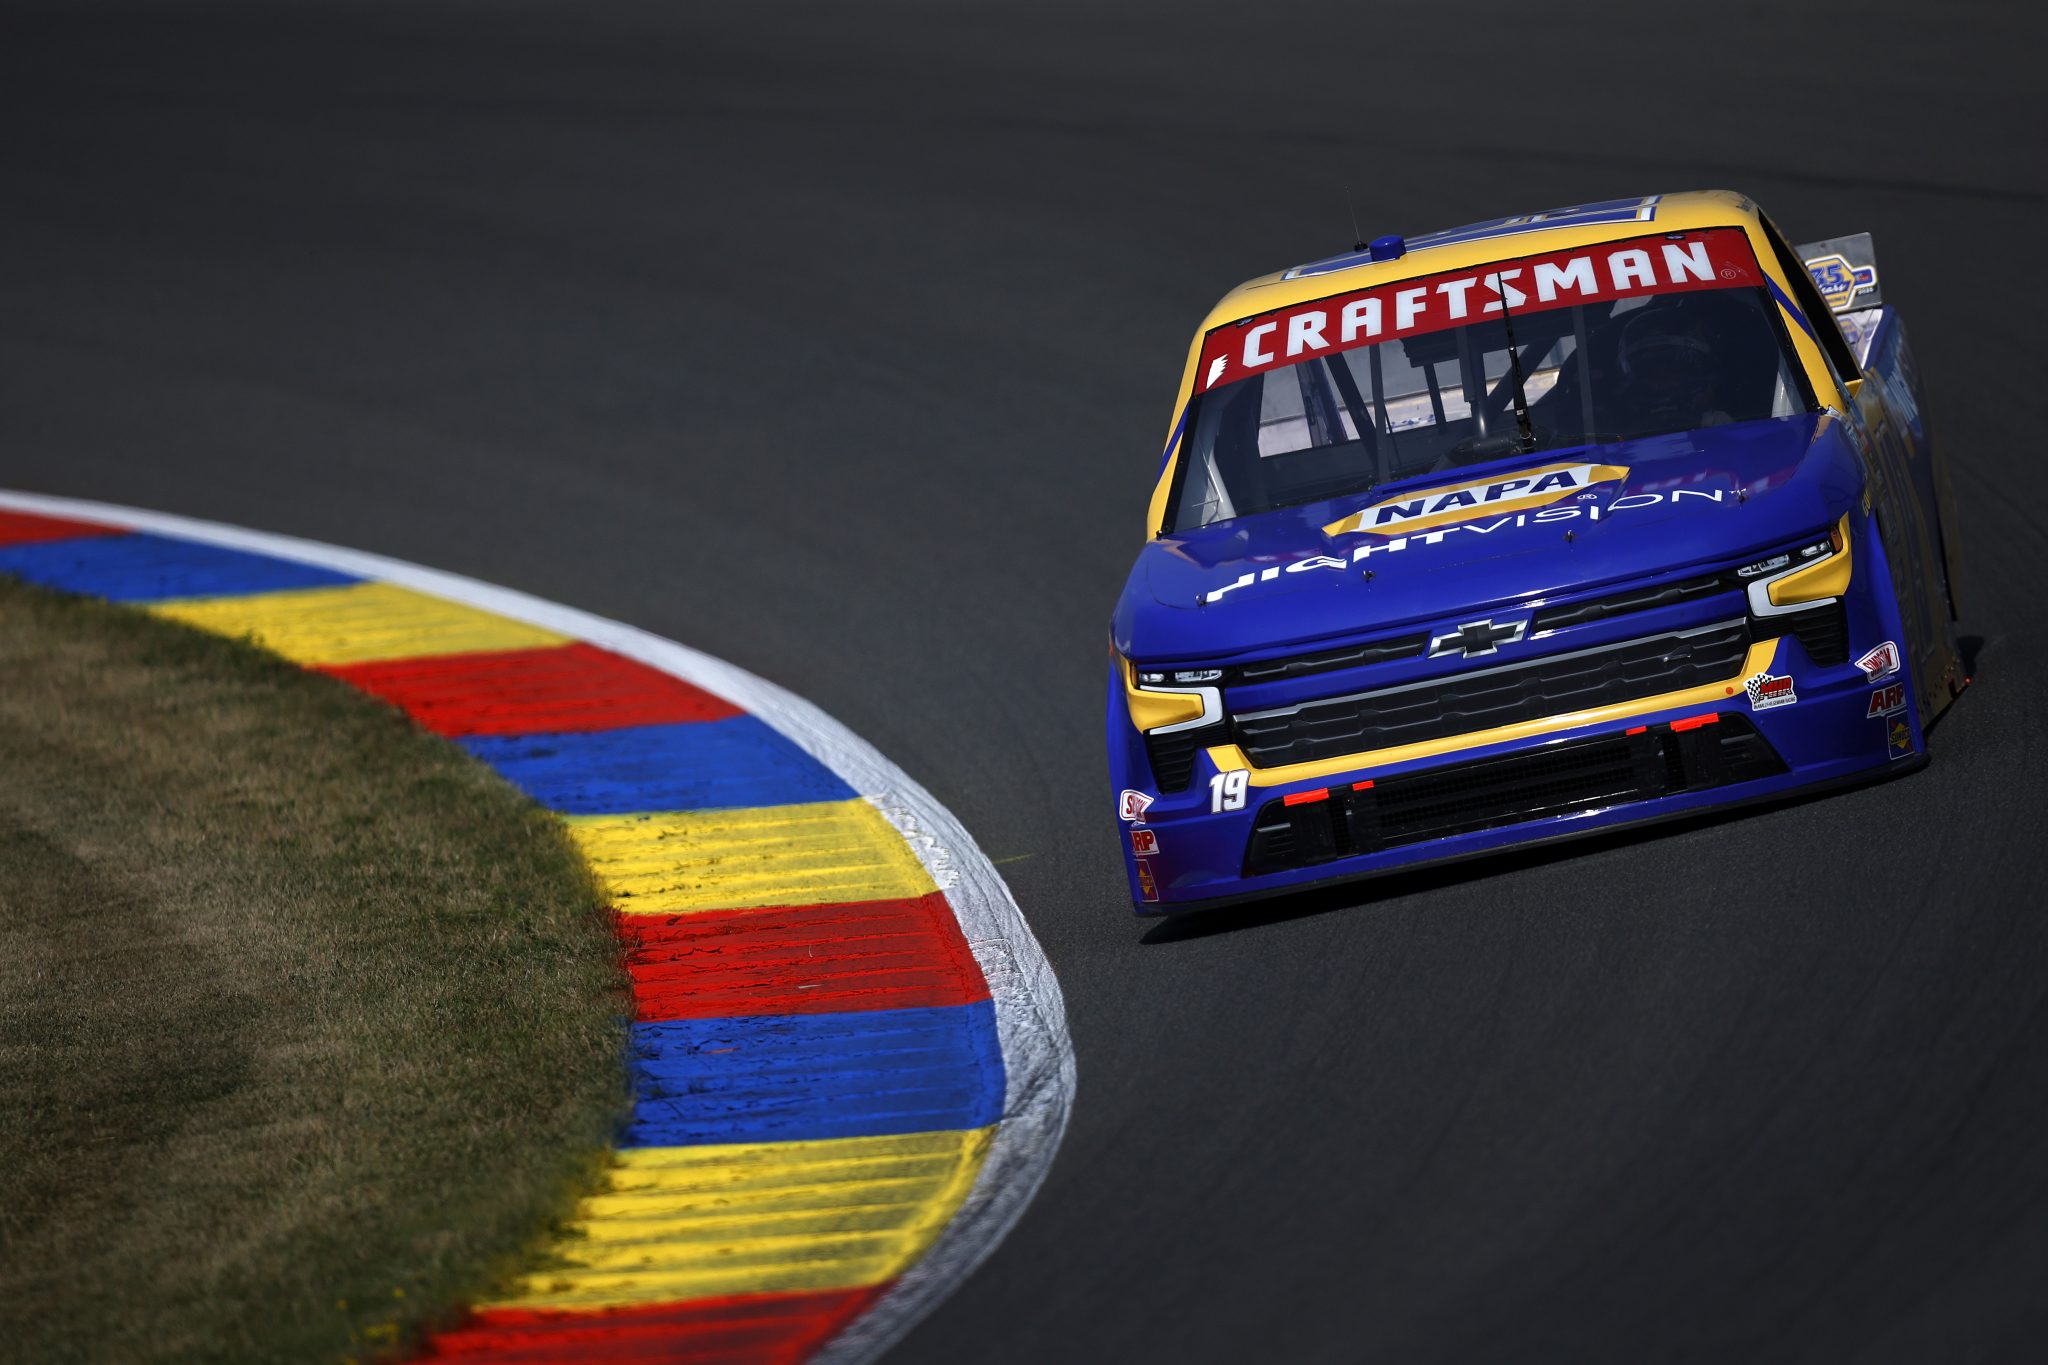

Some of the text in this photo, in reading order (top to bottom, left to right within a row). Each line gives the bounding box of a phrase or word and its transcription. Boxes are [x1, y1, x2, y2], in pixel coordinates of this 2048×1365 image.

[1242, 241, 1716, 369] CRAFTSMAN
[1375, 470, 1578, 525] NAPA
[1209, 769, 1250, 814] 19
[1132, 831, 1155, 852] RP
